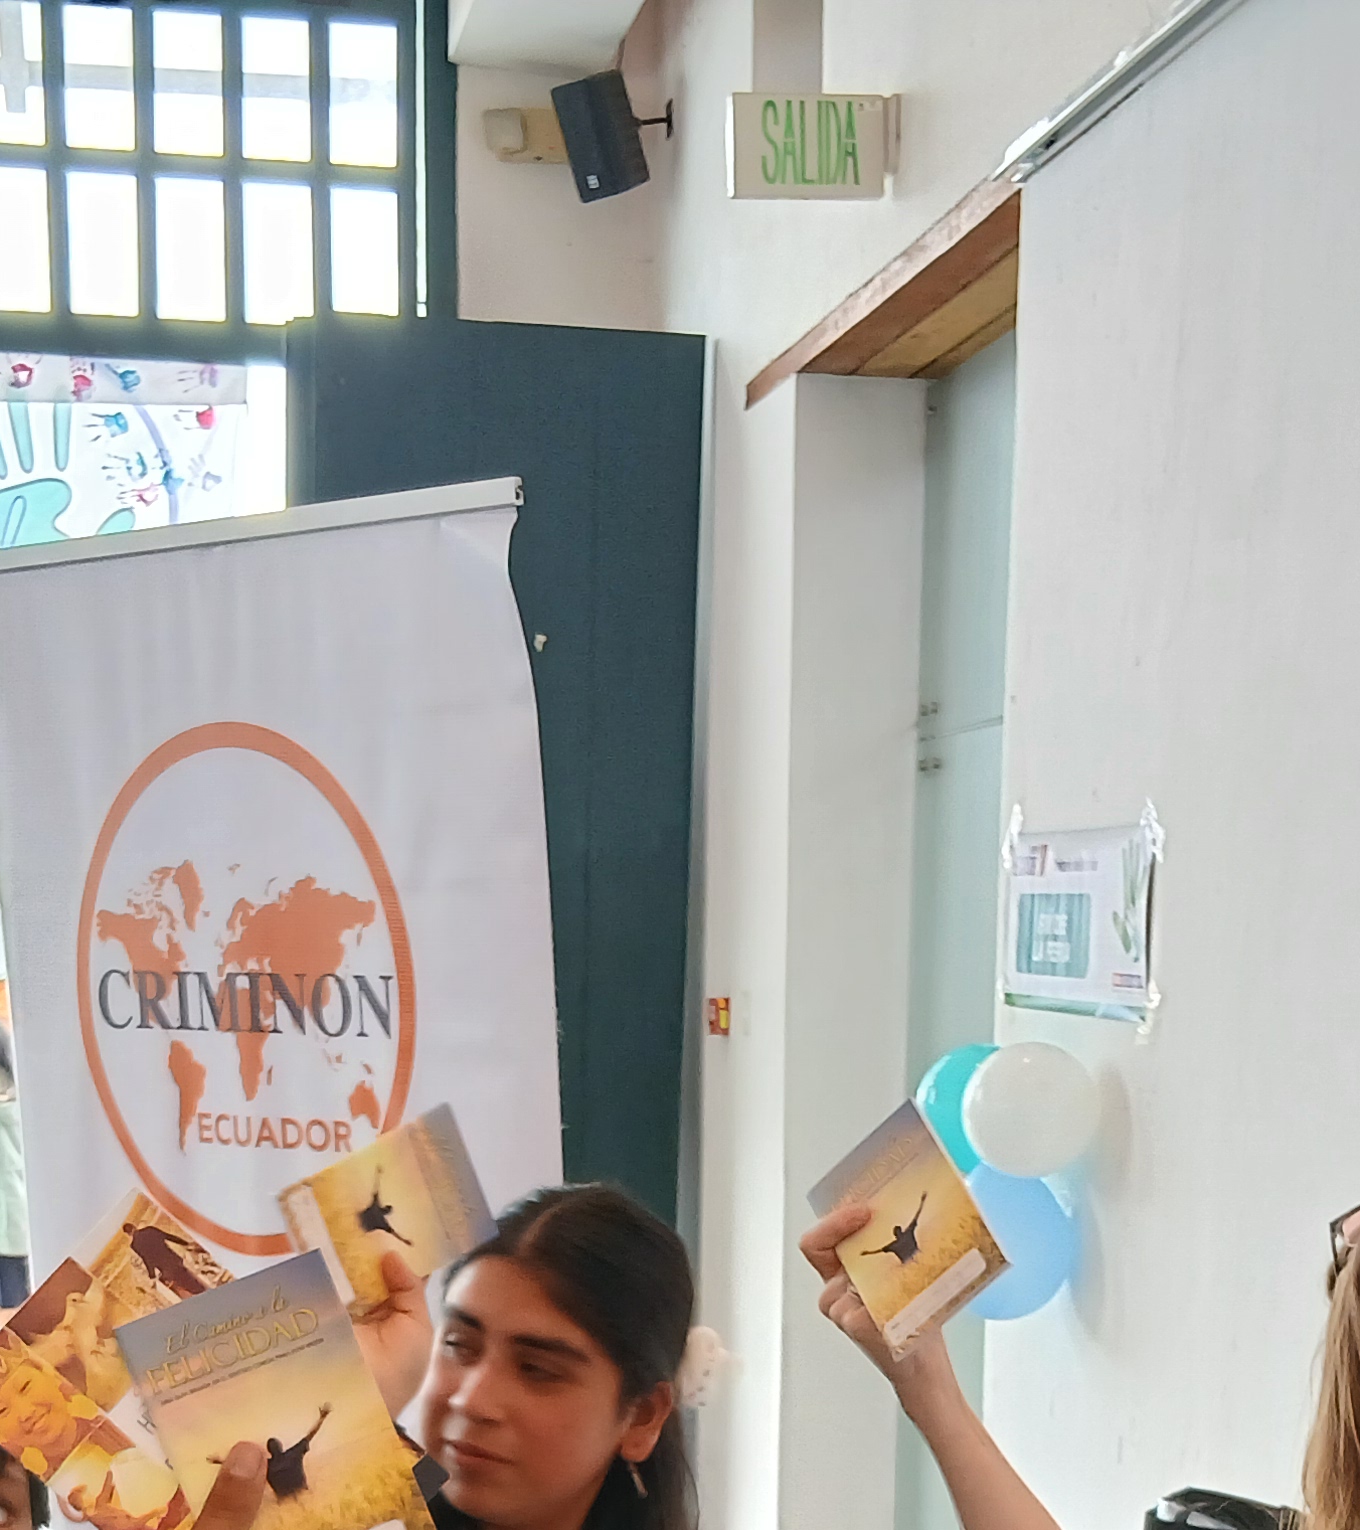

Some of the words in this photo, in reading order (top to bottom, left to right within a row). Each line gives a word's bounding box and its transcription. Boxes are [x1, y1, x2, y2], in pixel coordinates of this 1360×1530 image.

[761, 100, 860, 185] SALIDA
[98, 968, 394, 1039] CRIMINON
[197, 1112, 352, 1154] ECUADOR
[146, 1308, 320, 1396] FELICIDAD
